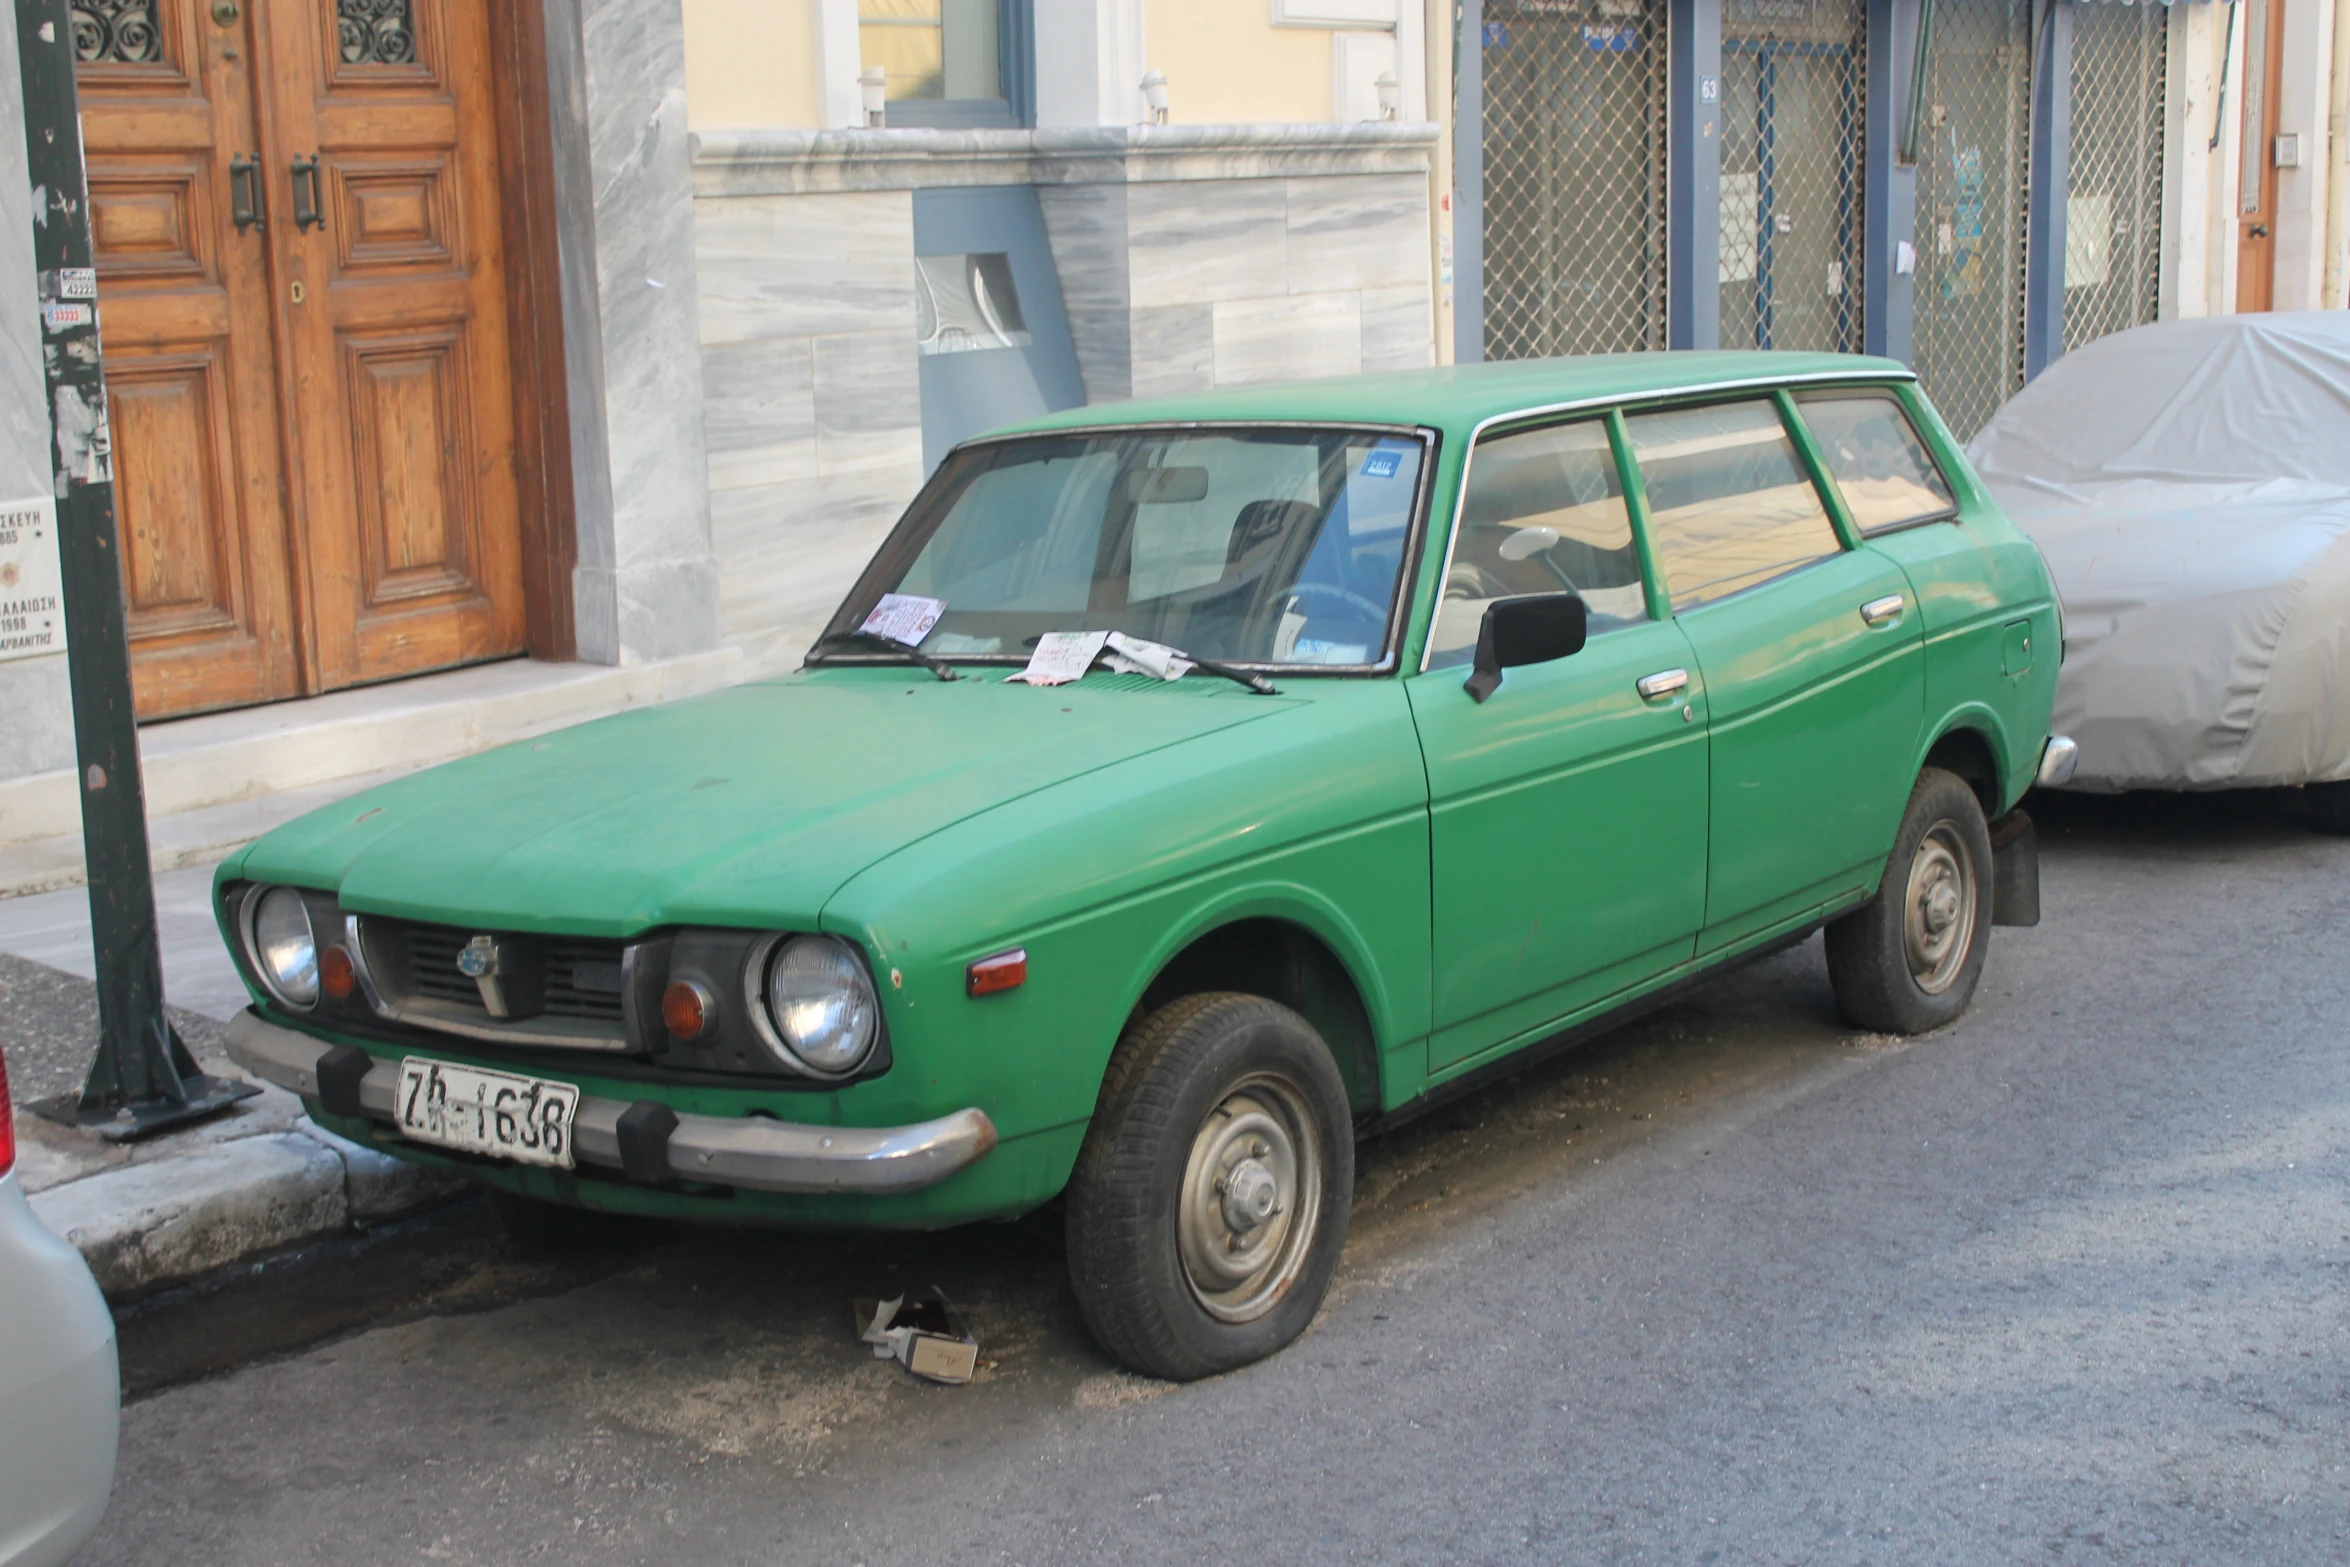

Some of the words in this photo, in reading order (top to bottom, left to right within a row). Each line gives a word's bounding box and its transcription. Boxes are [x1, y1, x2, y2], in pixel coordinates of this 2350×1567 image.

[1702, 80, 1716, 99] 63
[0, 596, 56, 616] ΑΛΑΙΩΣΗ
[1, 616, 27, 632] 1998
